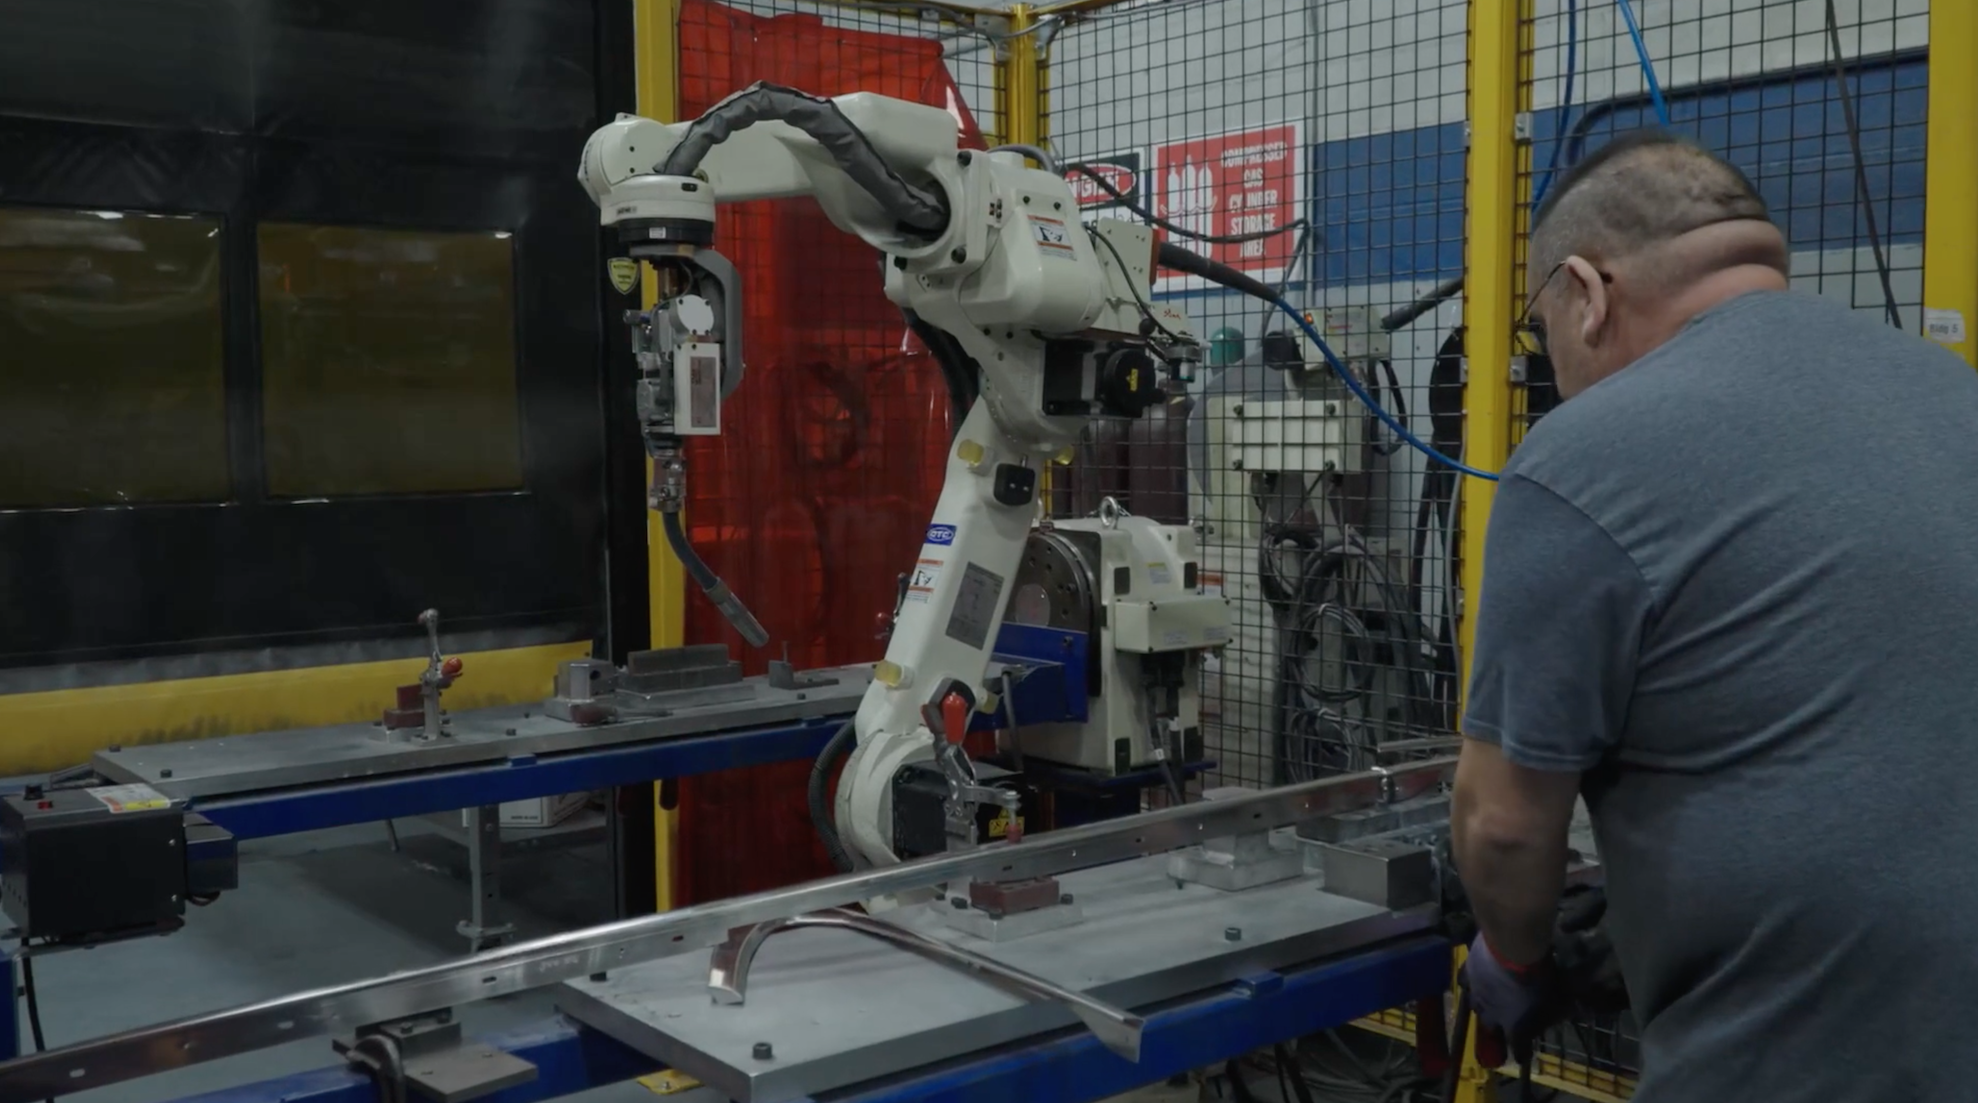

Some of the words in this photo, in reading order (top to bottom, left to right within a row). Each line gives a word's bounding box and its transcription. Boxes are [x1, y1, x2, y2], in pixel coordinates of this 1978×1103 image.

[1065, 171, 1119, 198] NGER
[1244, 168, 1264, 188] GAS
[1231, 213, 1276, 235] STORAGE
